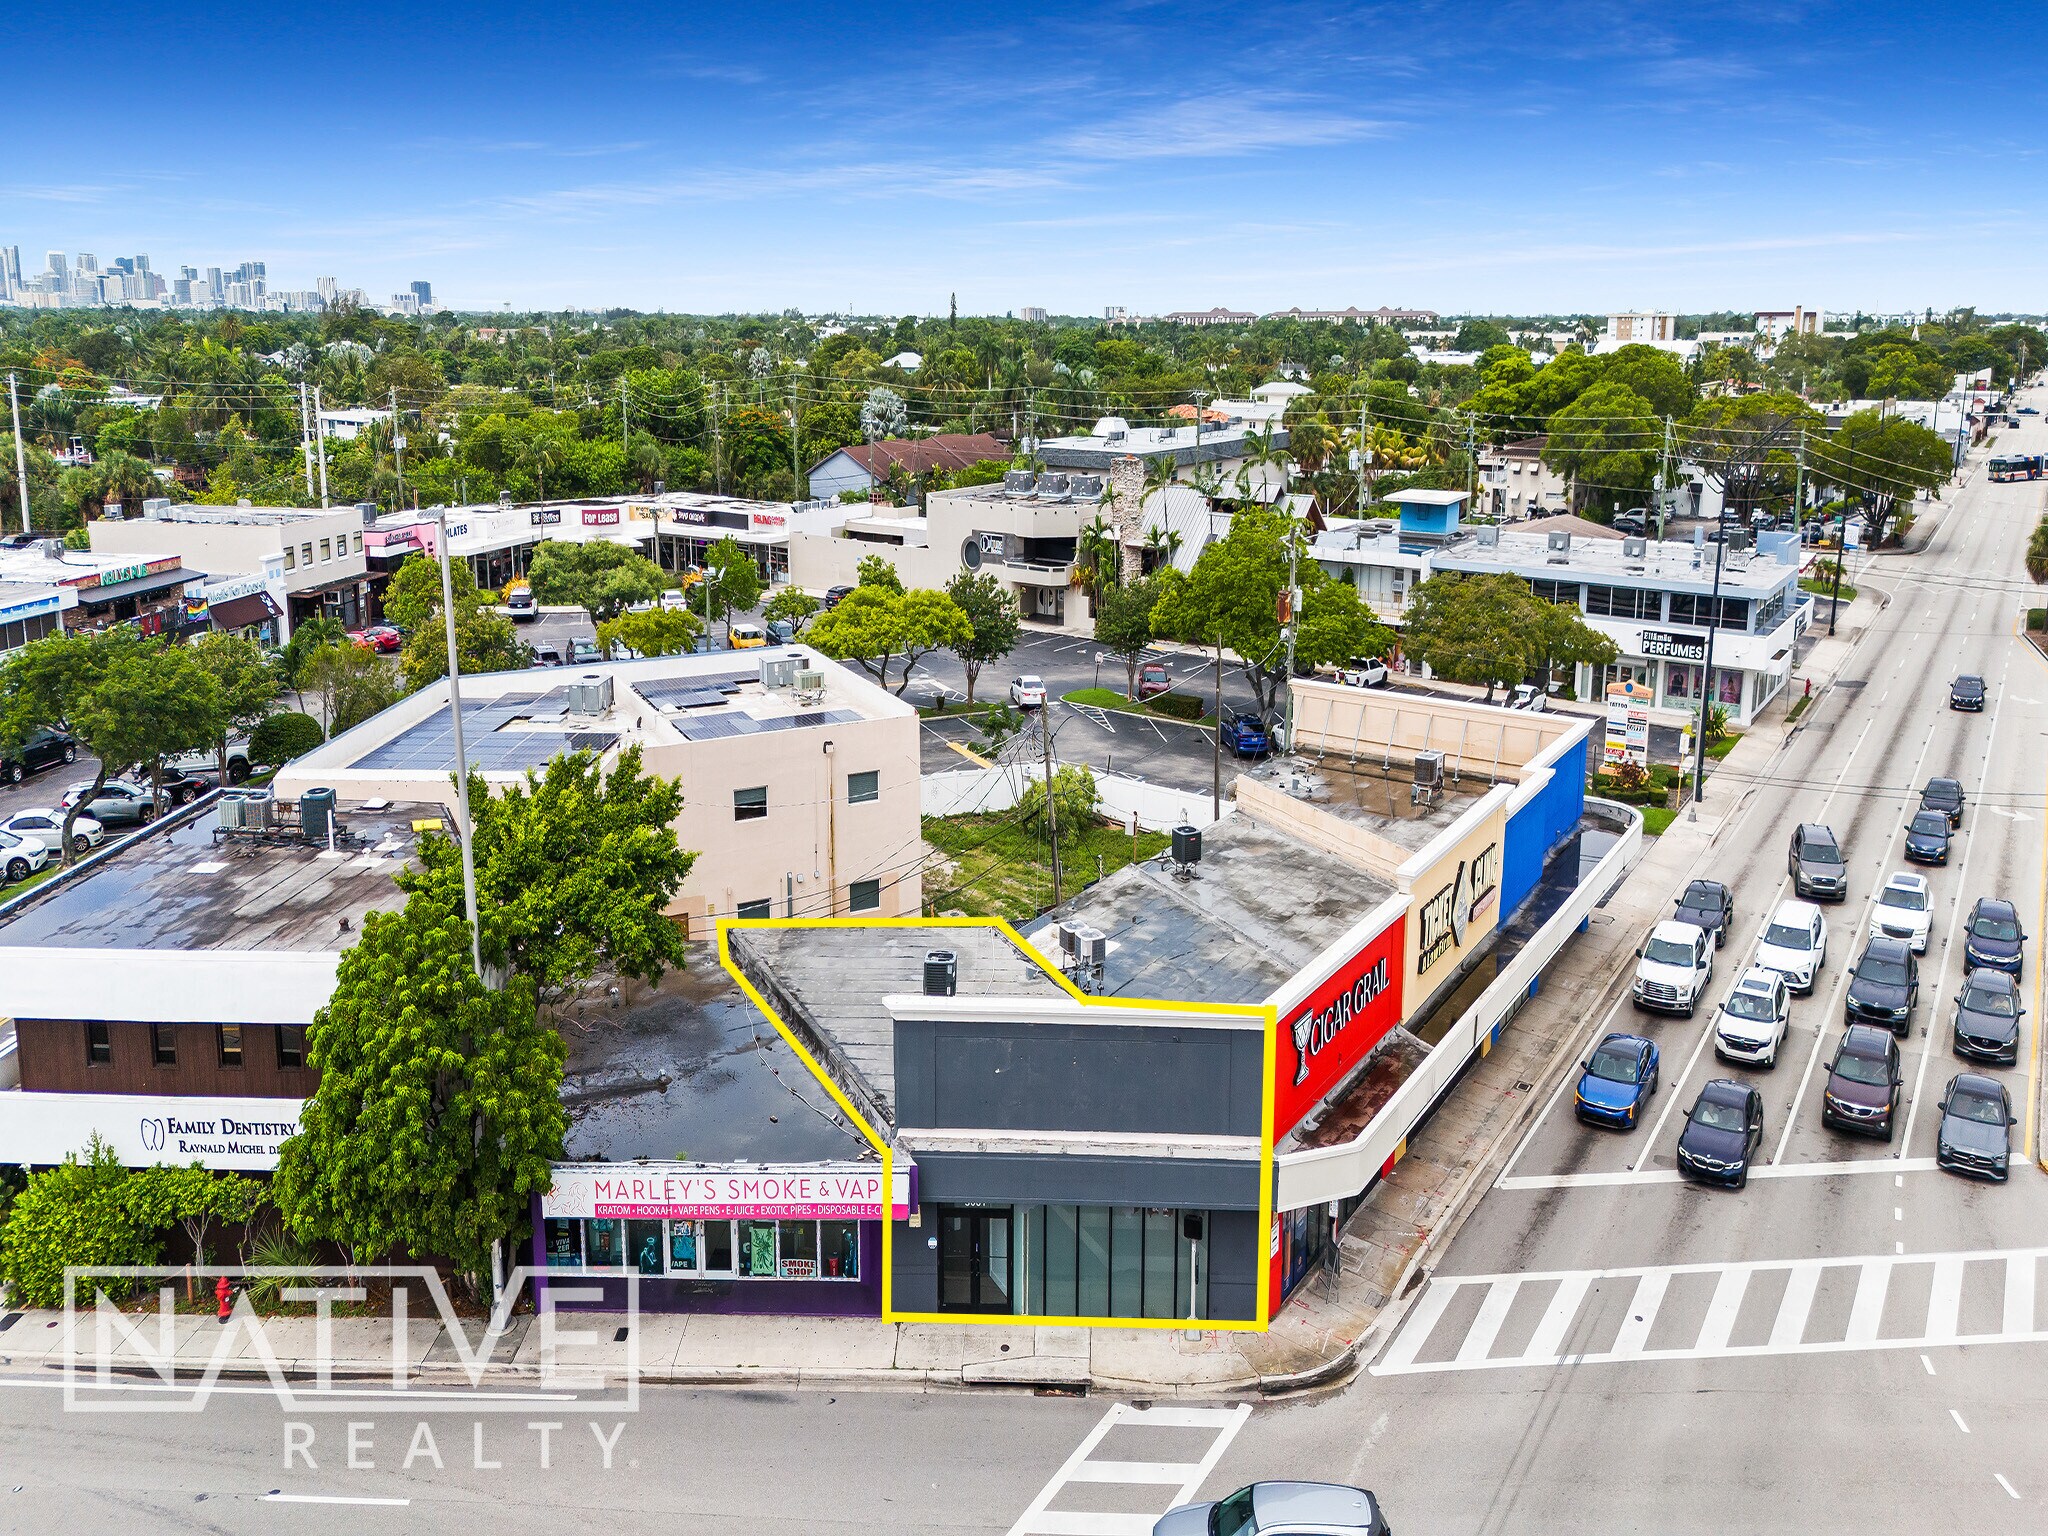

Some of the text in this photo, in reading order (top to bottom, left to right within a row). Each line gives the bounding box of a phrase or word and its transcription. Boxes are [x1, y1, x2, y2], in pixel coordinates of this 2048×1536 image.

[1643, 640, 1703, 659] PERFUMES
[1309, 957, 1390, 1056] CIGAR GRAIL
[167, 1117, 297, 1136] FAMILY DENTISTRY
[178, 1140, 226, 1154] RAYNALD
[227, 1141, 266, 1154] MICHEL
[595, 1179, 894, 1200] MARLEY'S SMOKE & VAP
[597, 1205, 631, 1215] KRATOM
[636, 1205, 672, 1215] HOOKAH
[678, 1205, 698, 1215] VAPE
[700, 1205, 720, 1215] PENS
[726, 1205, 755, 1215] E-JUICE
[760, 1205, 789, 1215] EXOTIC
[794, 1205, 811, 1215] PIPES
[817, 1205, 865, 1215] DISPOSABLE
[781, 1259, 816, 1269] SMOKE
[787, 1268, 813, 1277] SHOP
